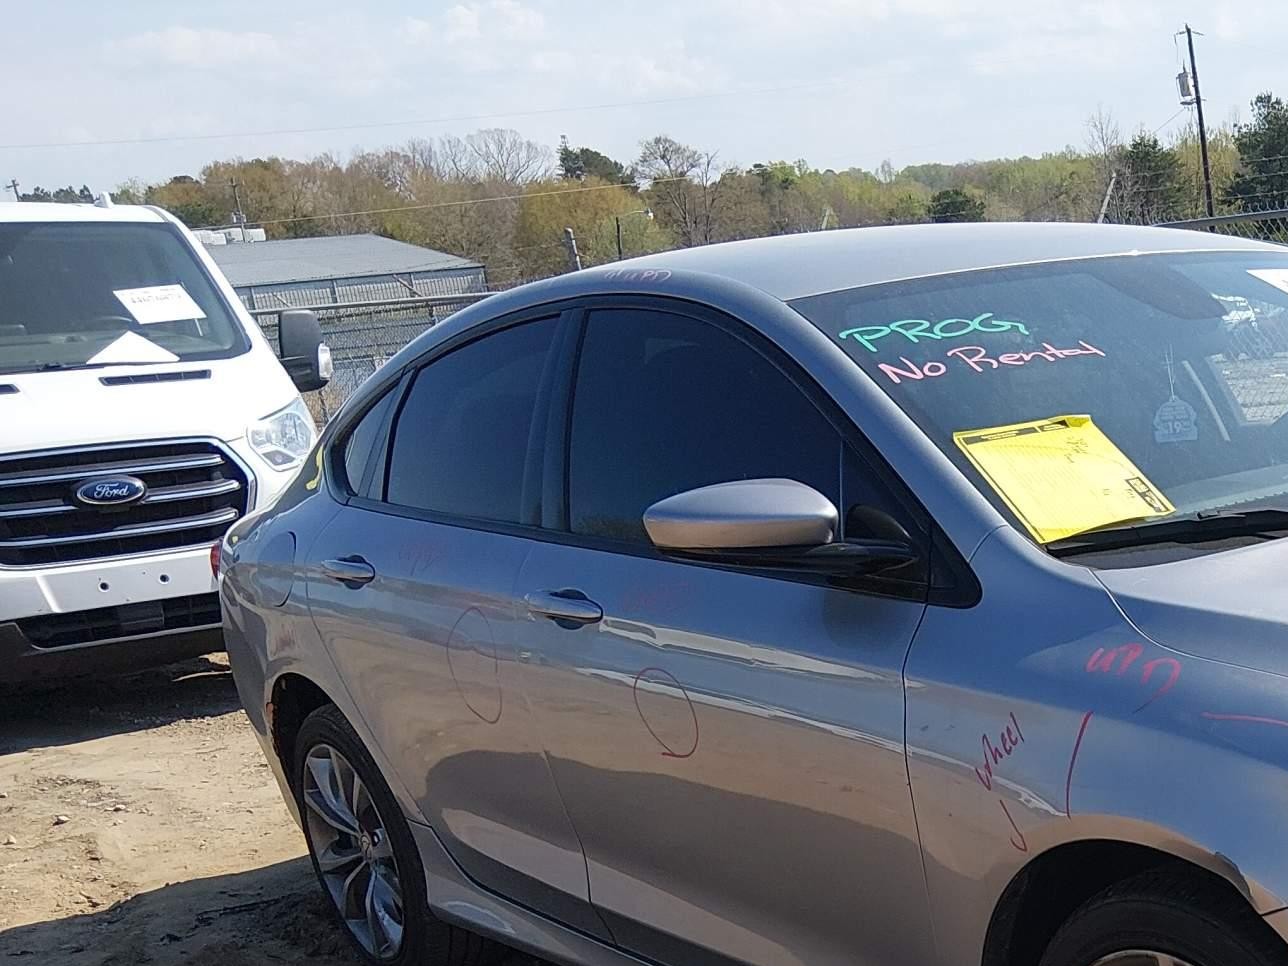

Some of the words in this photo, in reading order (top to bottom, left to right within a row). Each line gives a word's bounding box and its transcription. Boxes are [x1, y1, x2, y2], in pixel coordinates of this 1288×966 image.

[838, 312, 1030, 352] PROG
[877, 356, 947, 384] No
[946, 340, 1106, 372] Rental
[94, 482, 130, 498] Ford
